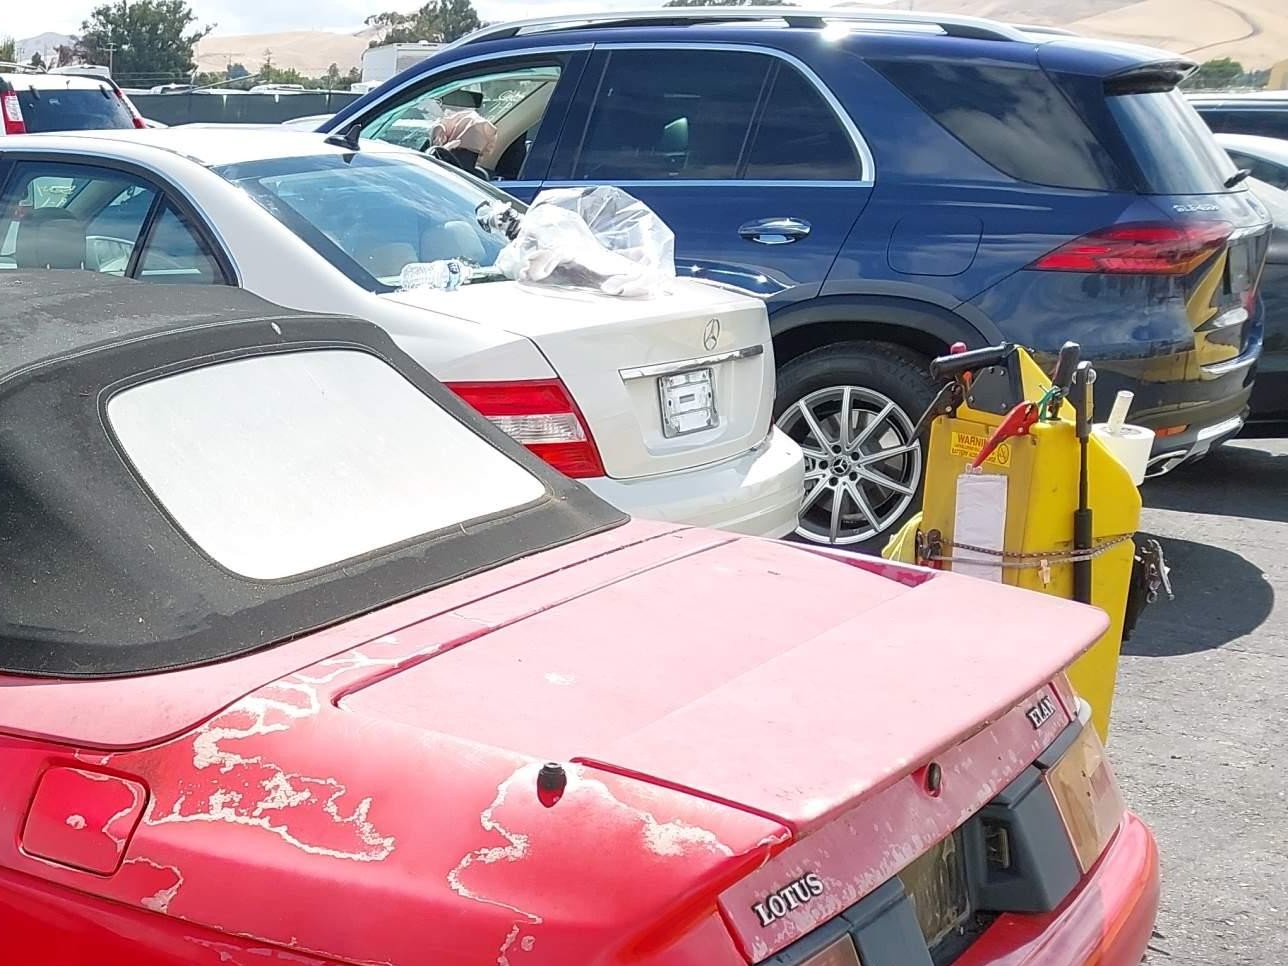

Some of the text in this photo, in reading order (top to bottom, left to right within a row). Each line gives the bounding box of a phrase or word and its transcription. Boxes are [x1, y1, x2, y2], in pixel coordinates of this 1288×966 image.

[957, 433, 986, 447] WARNI
[1025, 695, 1056, 730] ELAN
[751, 872, 824, 927] LOTUS
